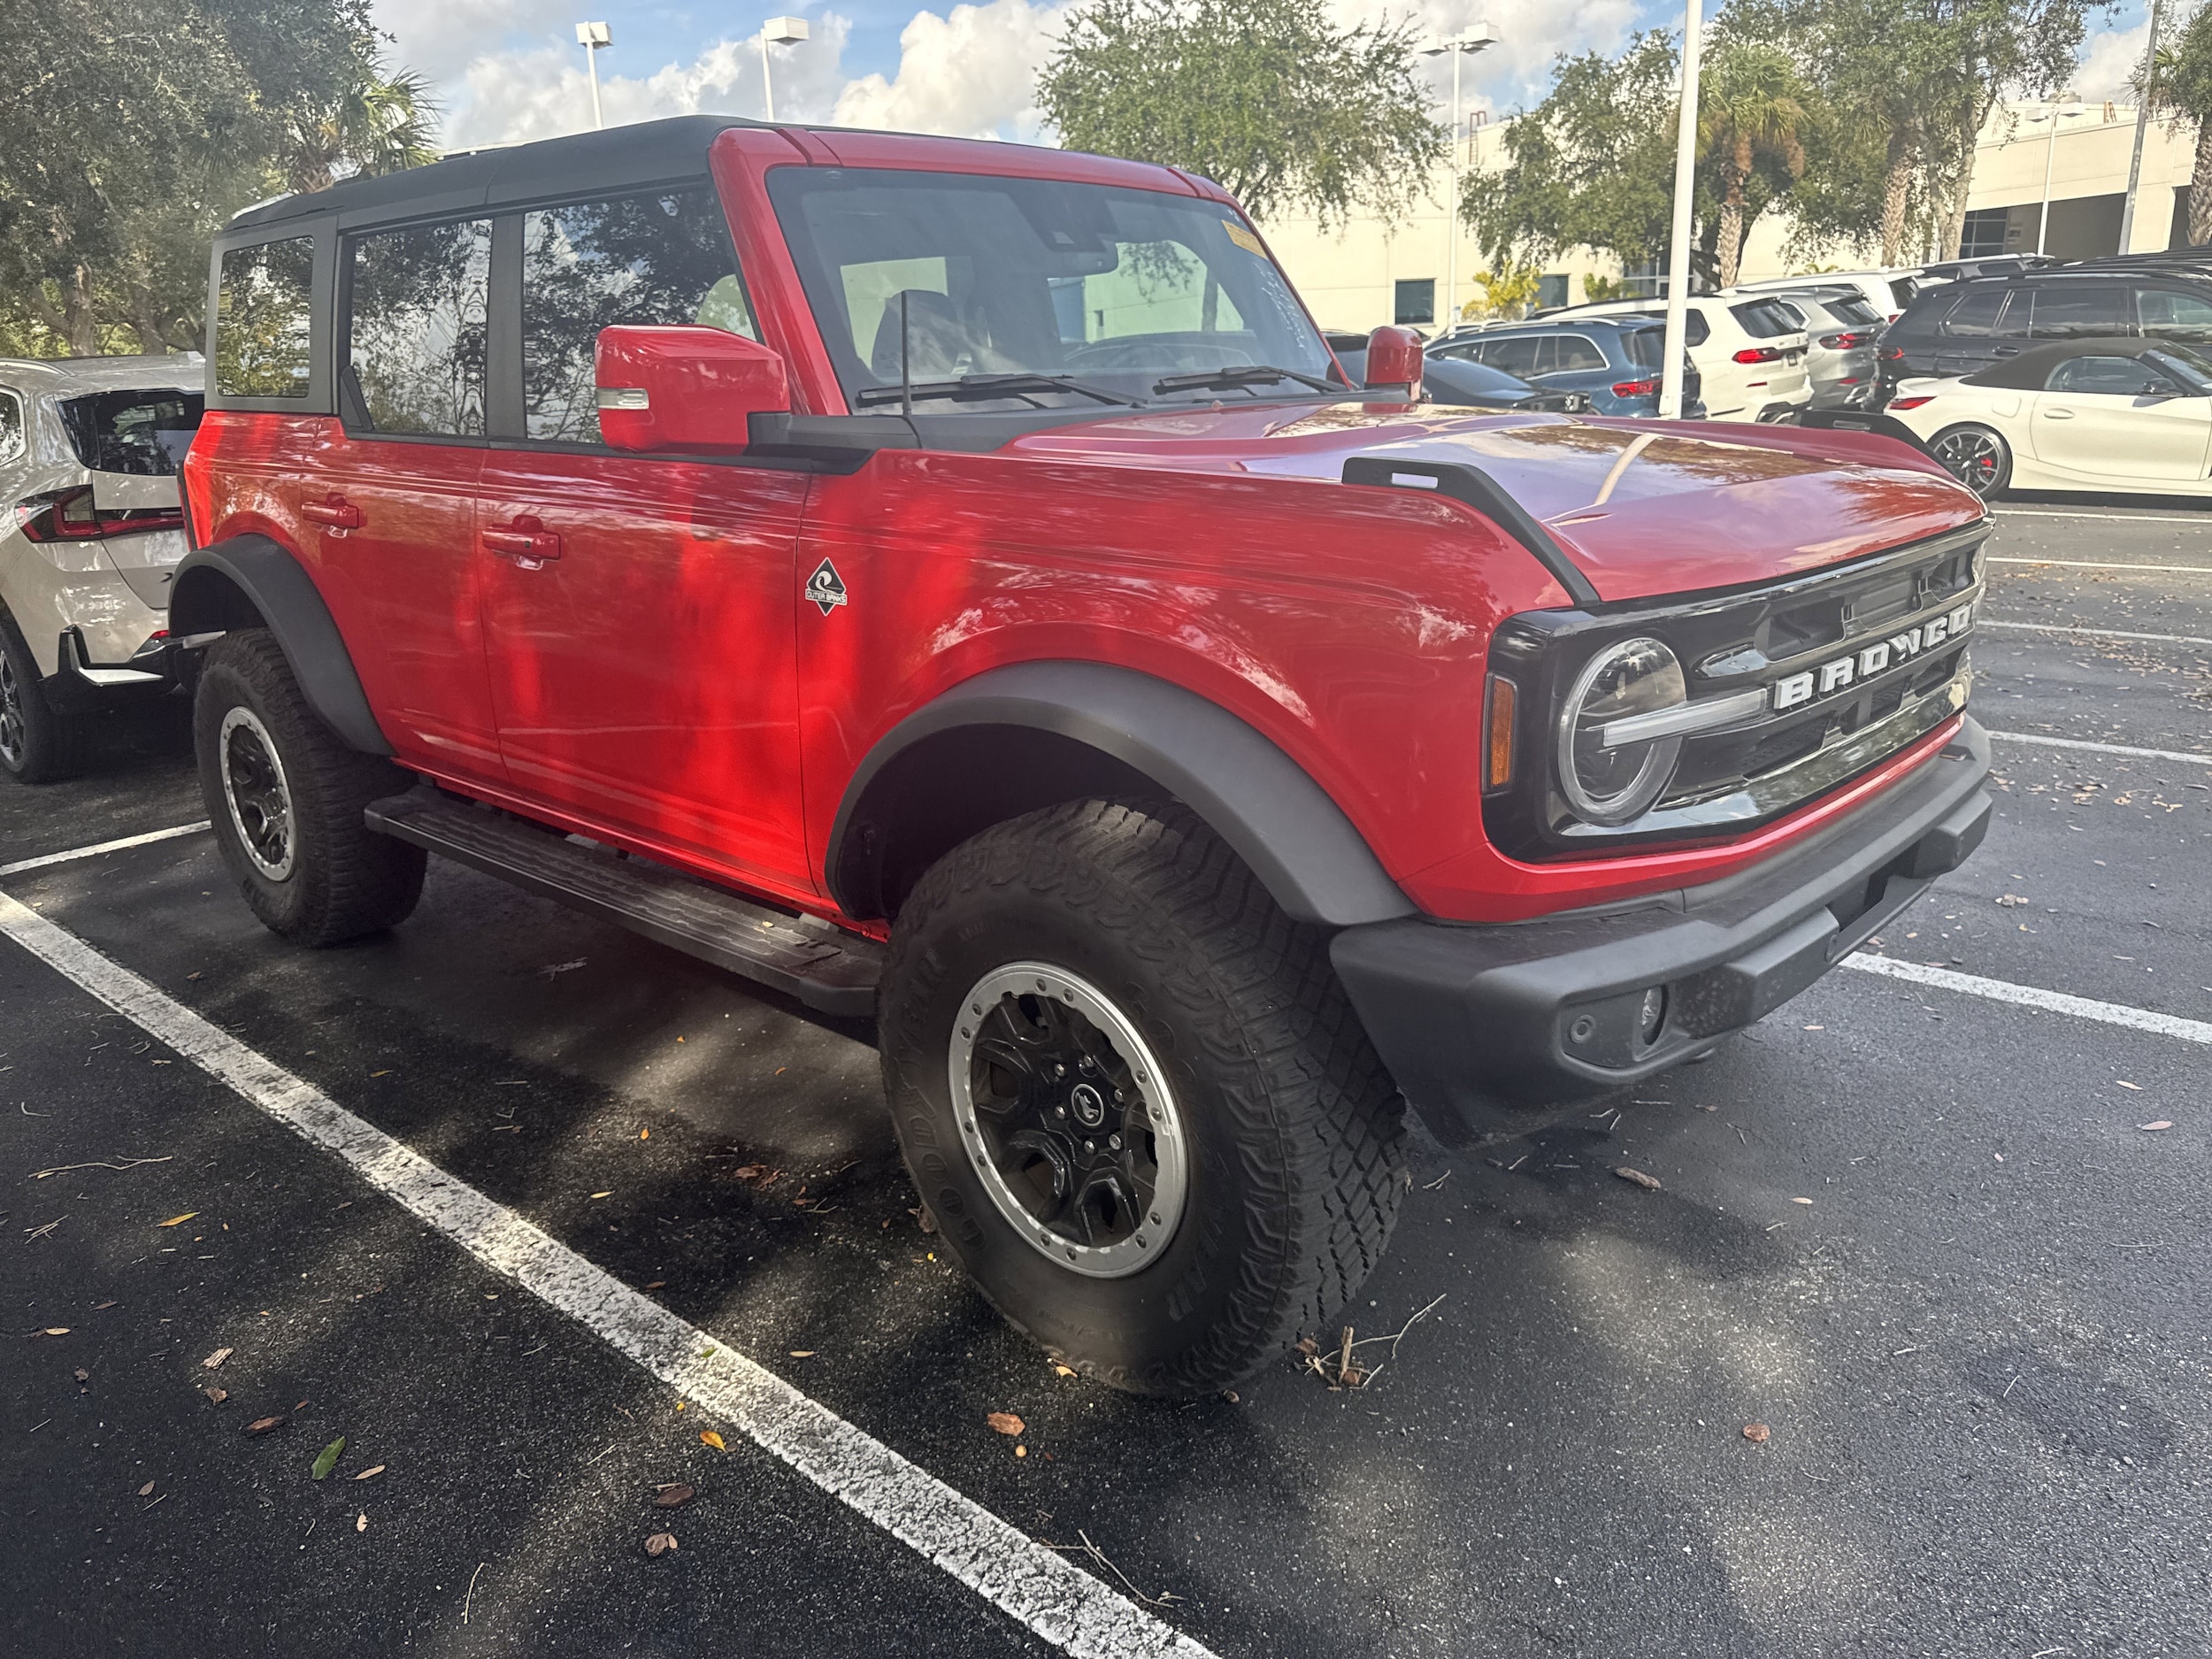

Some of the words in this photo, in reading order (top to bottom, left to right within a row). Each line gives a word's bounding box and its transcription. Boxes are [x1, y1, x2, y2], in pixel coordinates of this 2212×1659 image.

[807, 591, 826, 601] OUTER
[826, 594, 846, 603] BANKS
[1774, 603, 1972, 709] BRONCO
